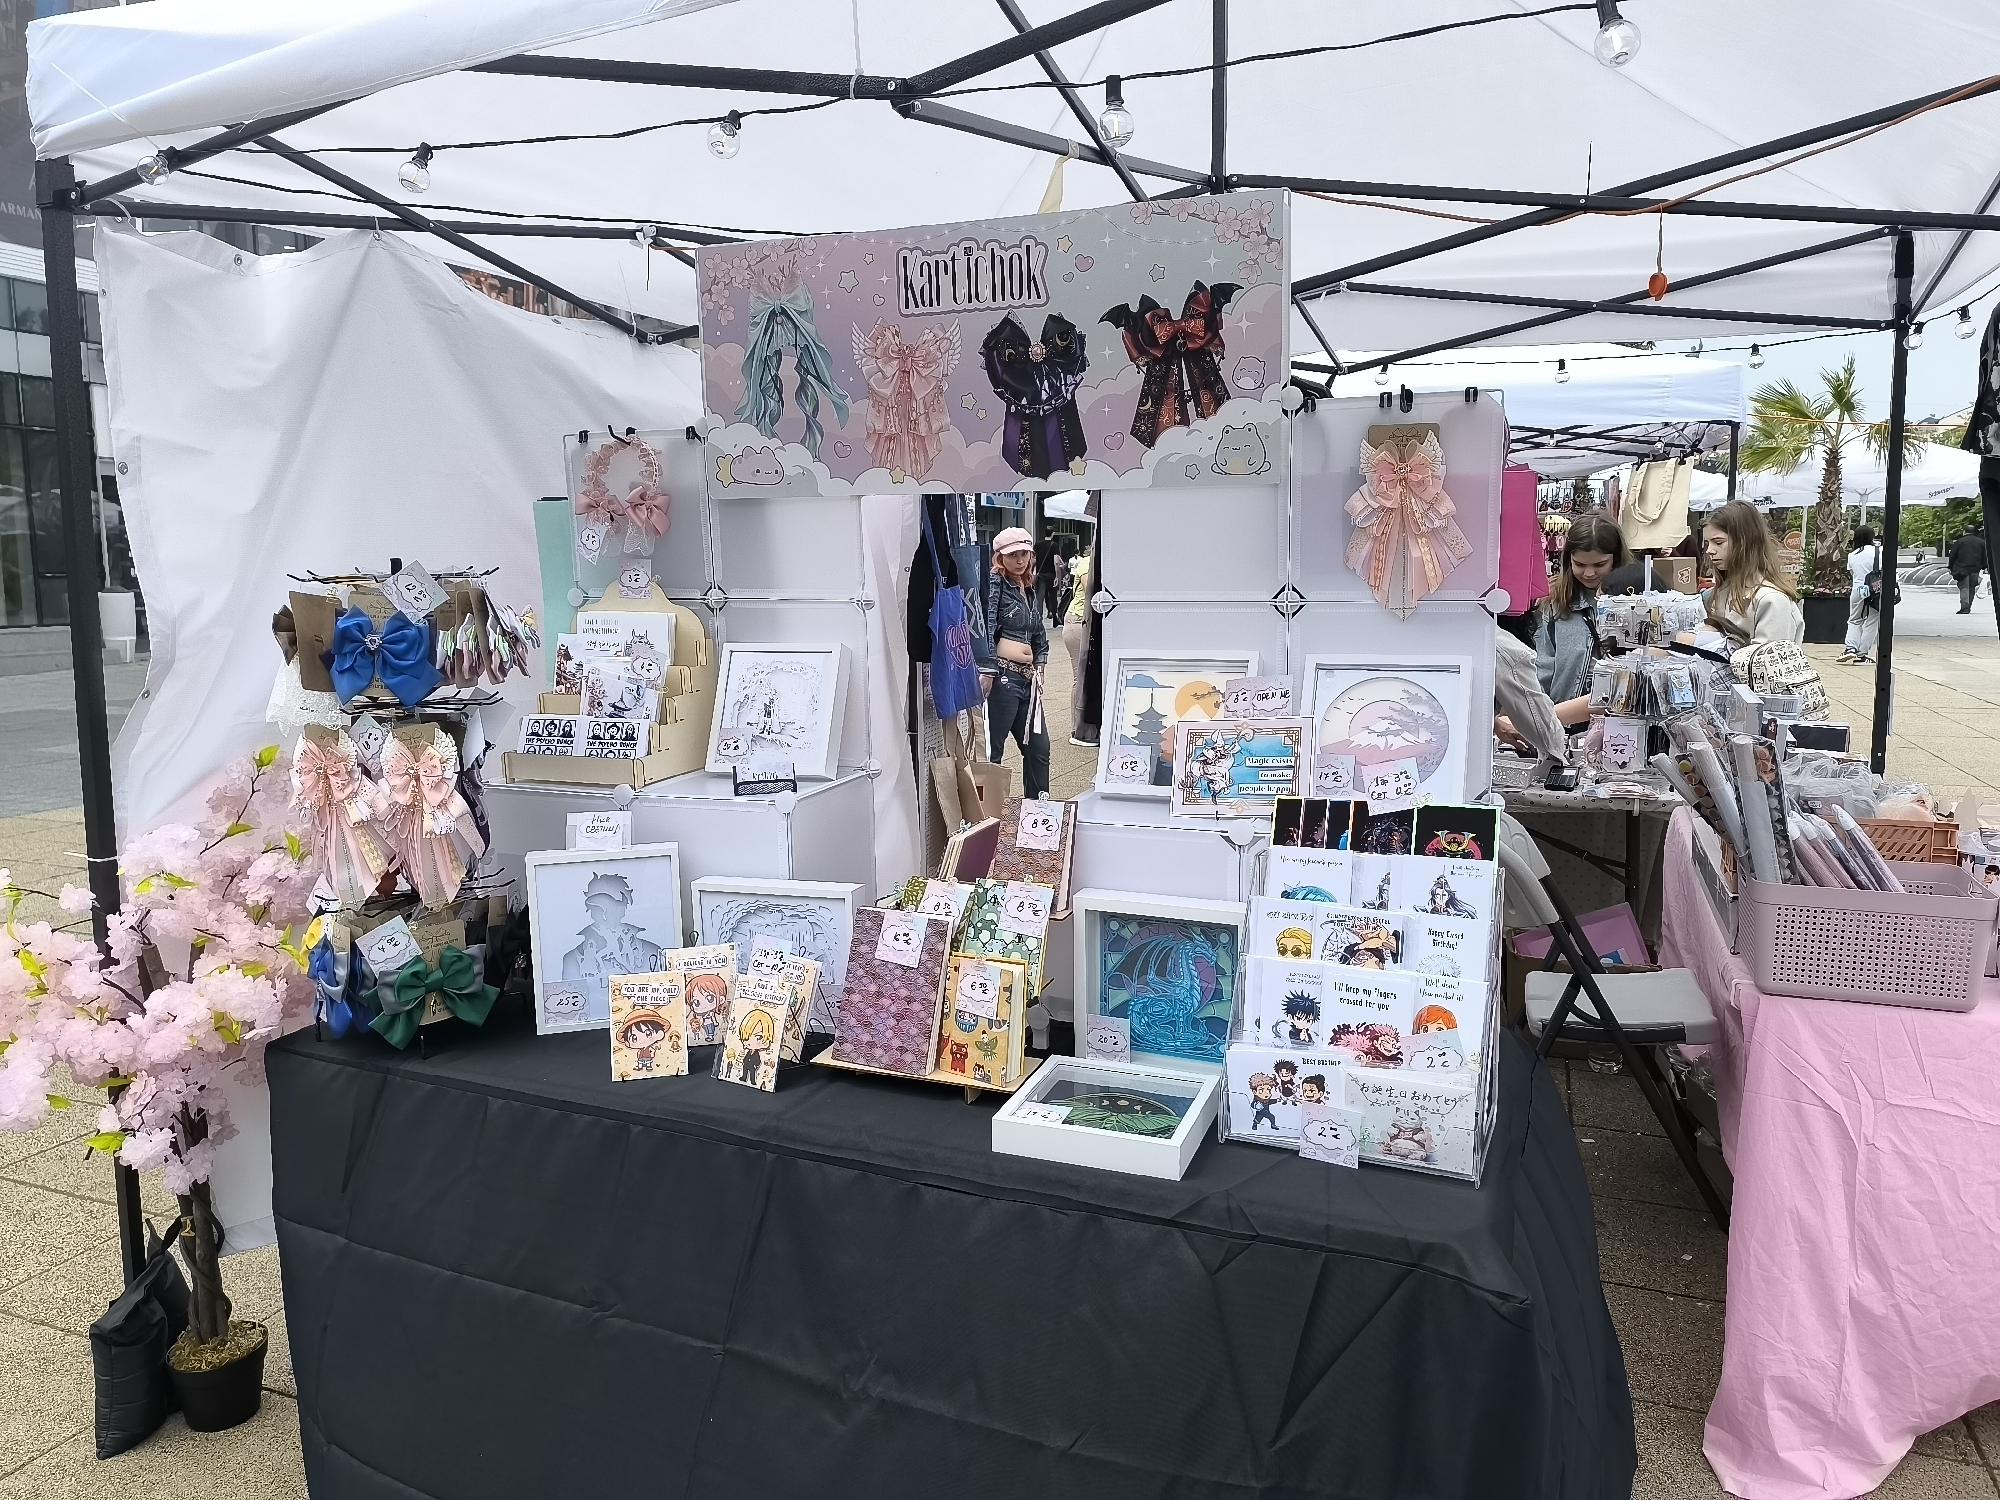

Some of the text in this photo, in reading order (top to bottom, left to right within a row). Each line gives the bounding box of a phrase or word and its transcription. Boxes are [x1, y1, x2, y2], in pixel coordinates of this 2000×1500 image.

[0, 201, 42, 220] ARMAN
[902, 245, 1042, 310] Kartichok
[1256, 692, 1277, 702] OPEN
[1239, 784, 1291, 794] people happy
[1427, 927, 1445, 938] Happy
[1345, 983, 1360, 995] keep
[1362, 988, 1372, 997] my
[1339, 997, 1390, 1011] crossed for you
[1301, 1057, 1317, 1066] BEST
